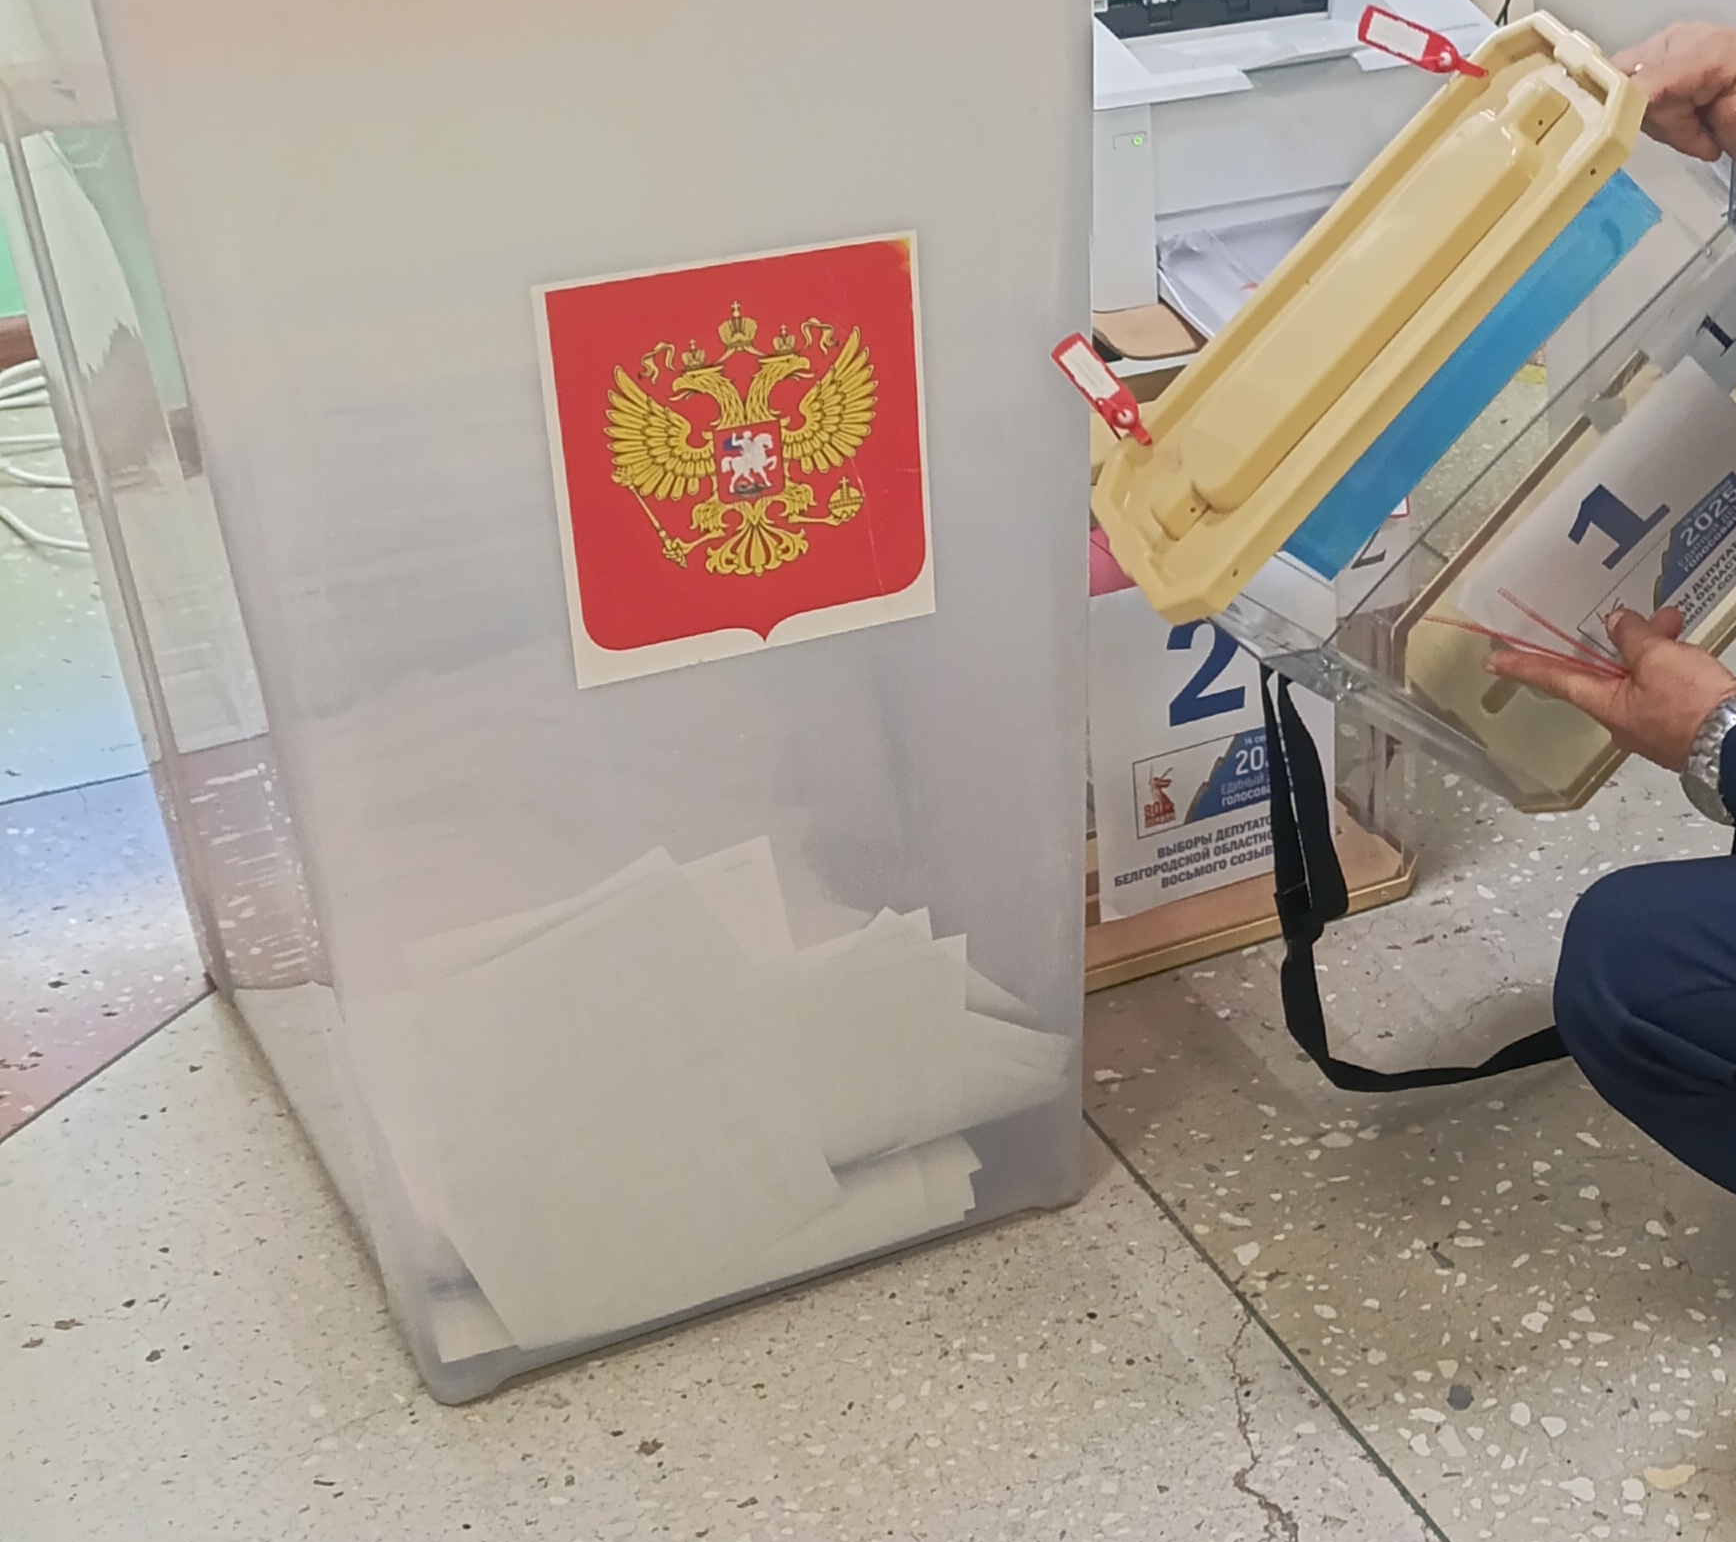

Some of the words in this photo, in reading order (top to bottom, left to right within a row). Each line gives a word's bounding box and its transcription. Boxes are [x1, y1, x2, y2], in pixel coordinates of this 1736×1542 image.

[1568, 484, 1671, 570] 1
[1166, 617, 1246, 727] 2
[1235, 746, 1270, 776] 20
[1221, 785, 1272, 808] голосова
[1114, 847, 1211, 888] БЕЛГОРОДСКОЙ
[1213, 830, 1274, 856] ОБЛАСТНО
[1156, 833, 1213, 859] ВЫБОРЫ
[1215, 815, 1273, 842] ДЕПУТАТО
[1161, 861, 1228, 889] ВОСЬМОГО
[1230, 844, 1275, 868] СОЗЫВ
